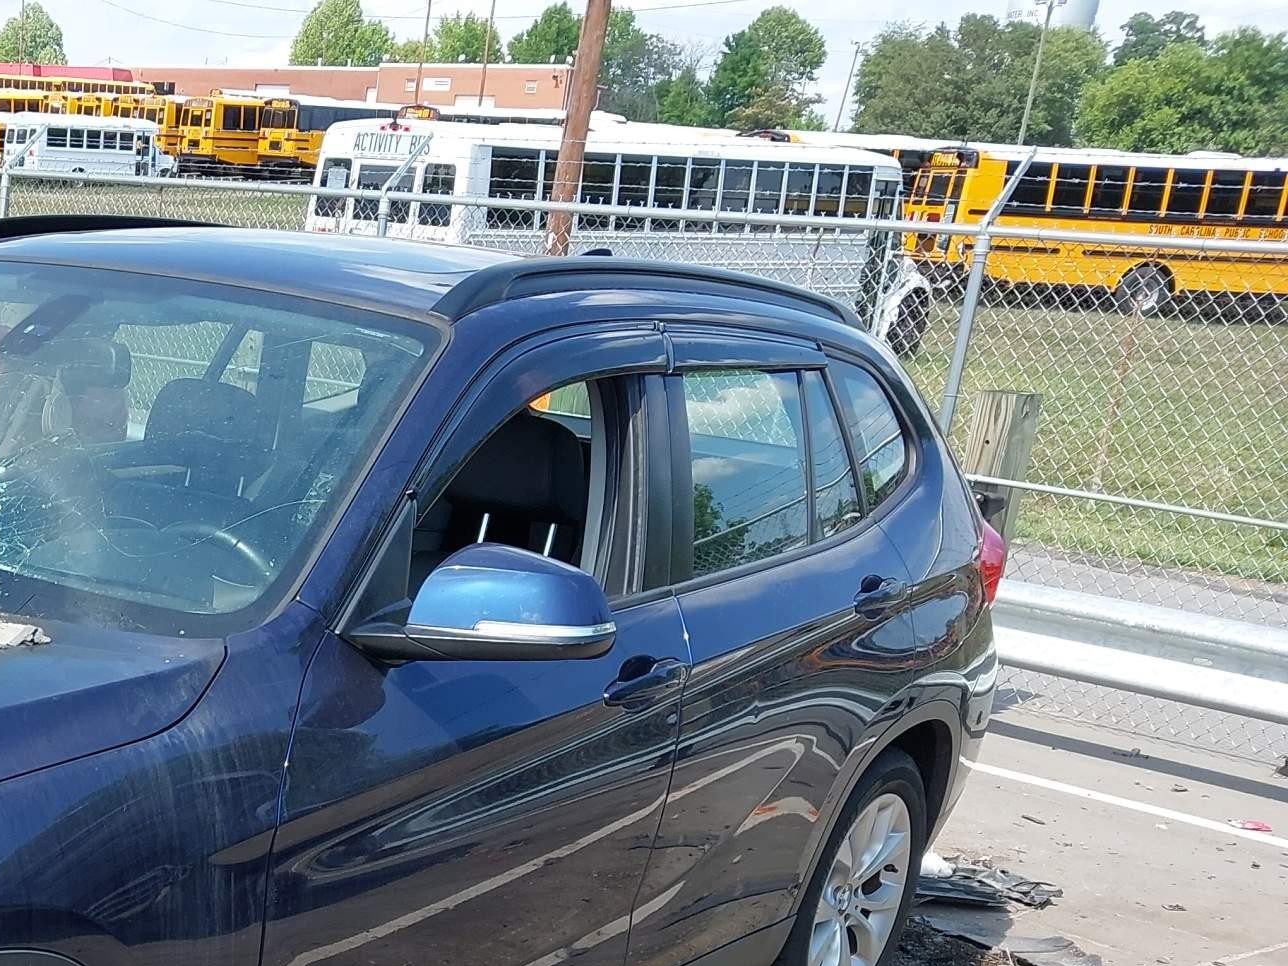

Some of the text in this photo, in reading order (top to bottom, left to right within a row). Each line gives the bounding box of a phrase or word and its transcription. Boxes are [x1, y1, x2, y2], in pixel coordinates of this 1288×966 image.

[354, 132, 402, 153] ACTIVITY
[1148, 224, 1173, 235] SOUTH
[1224, 227, 1251, 238] PUBIC
